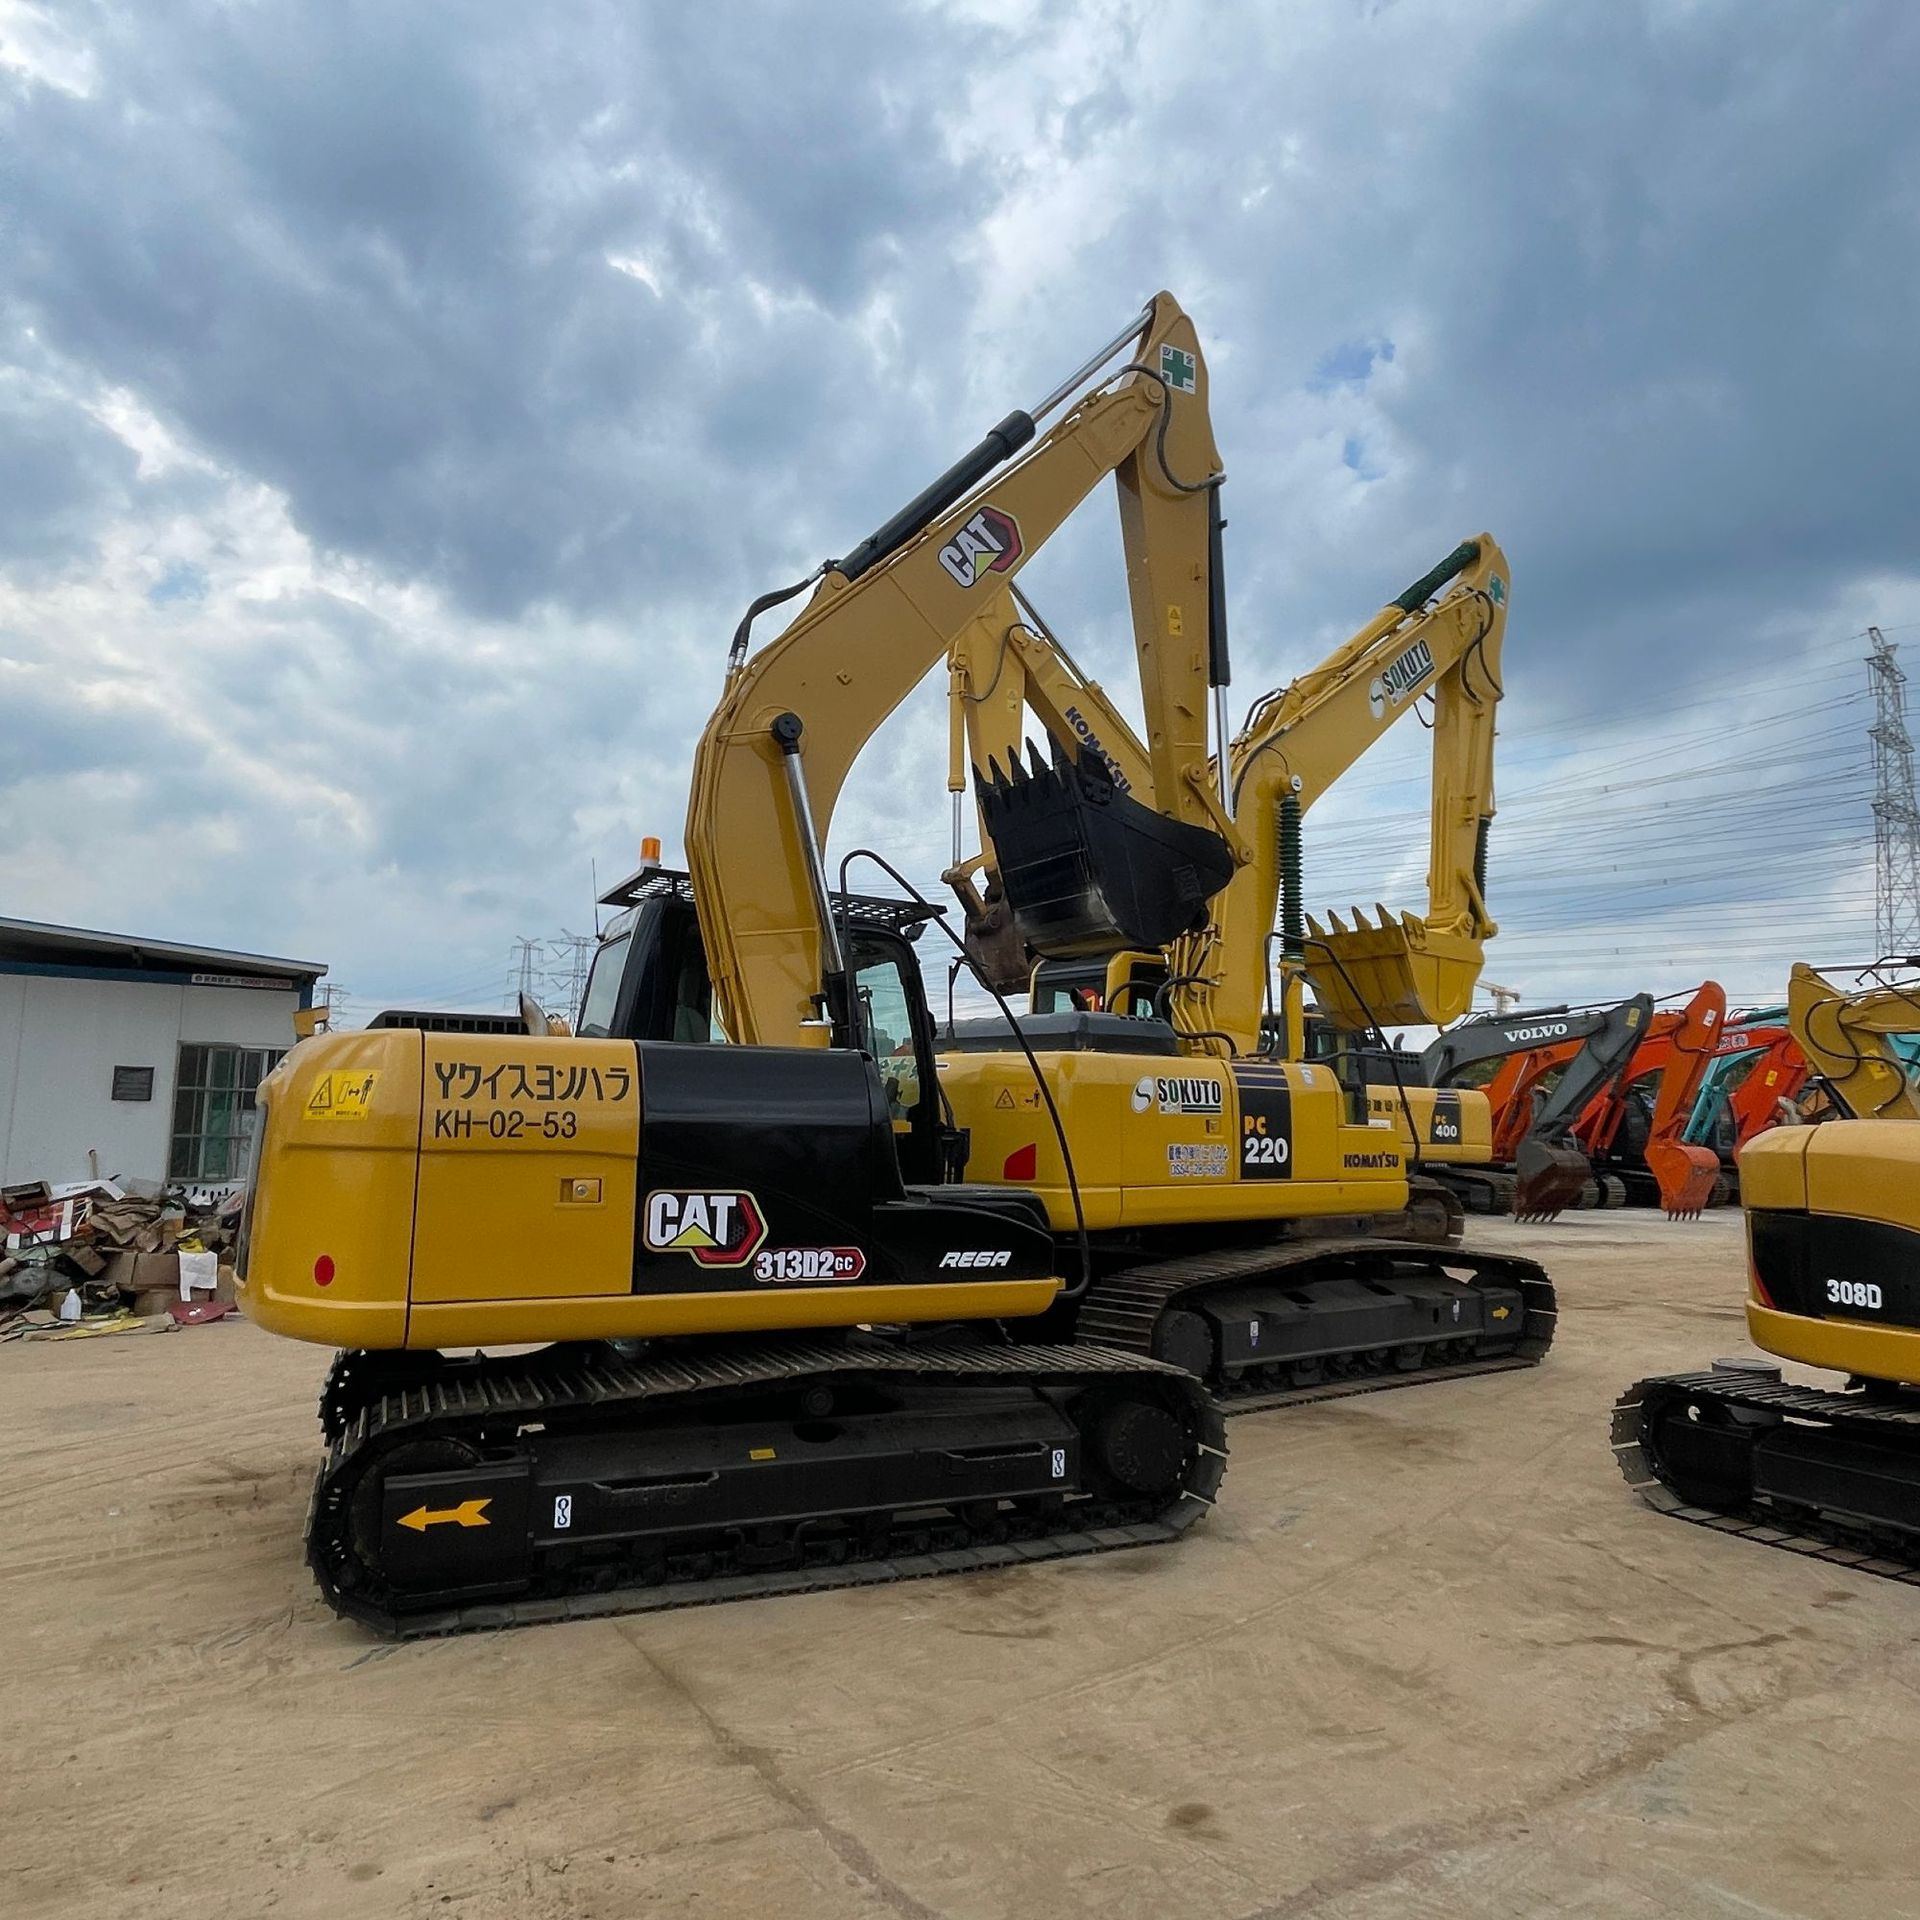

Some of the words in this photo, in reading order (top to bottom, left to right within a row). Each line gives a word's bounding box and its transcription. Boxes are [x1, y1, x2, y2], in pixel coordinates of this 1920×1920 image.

[938, 512, 1004, 587] CAT
[1381, 639, 1432, 694] SOKUTO
[1503, 1023, 1568, 1042] VOLVO
[1157, 1078, 1221, 1104] SOKUTO
[434, 1109, 577, 1139] KH-02-53
[1244, 1115, 1267, 1135] PC
[1435, 1115, 1447, 1124] PC
[1435, 1125, 1458, 1138] 400
[1244, 1137, 1289, 1164] 220
[1344, 1151, 1399, 1169] KOMATSU
[649, 1193, 737, 1247] CAT
[938, 1250, 1012, 1268] REGA
[1826, 1279, 1883, 1309] 308D
